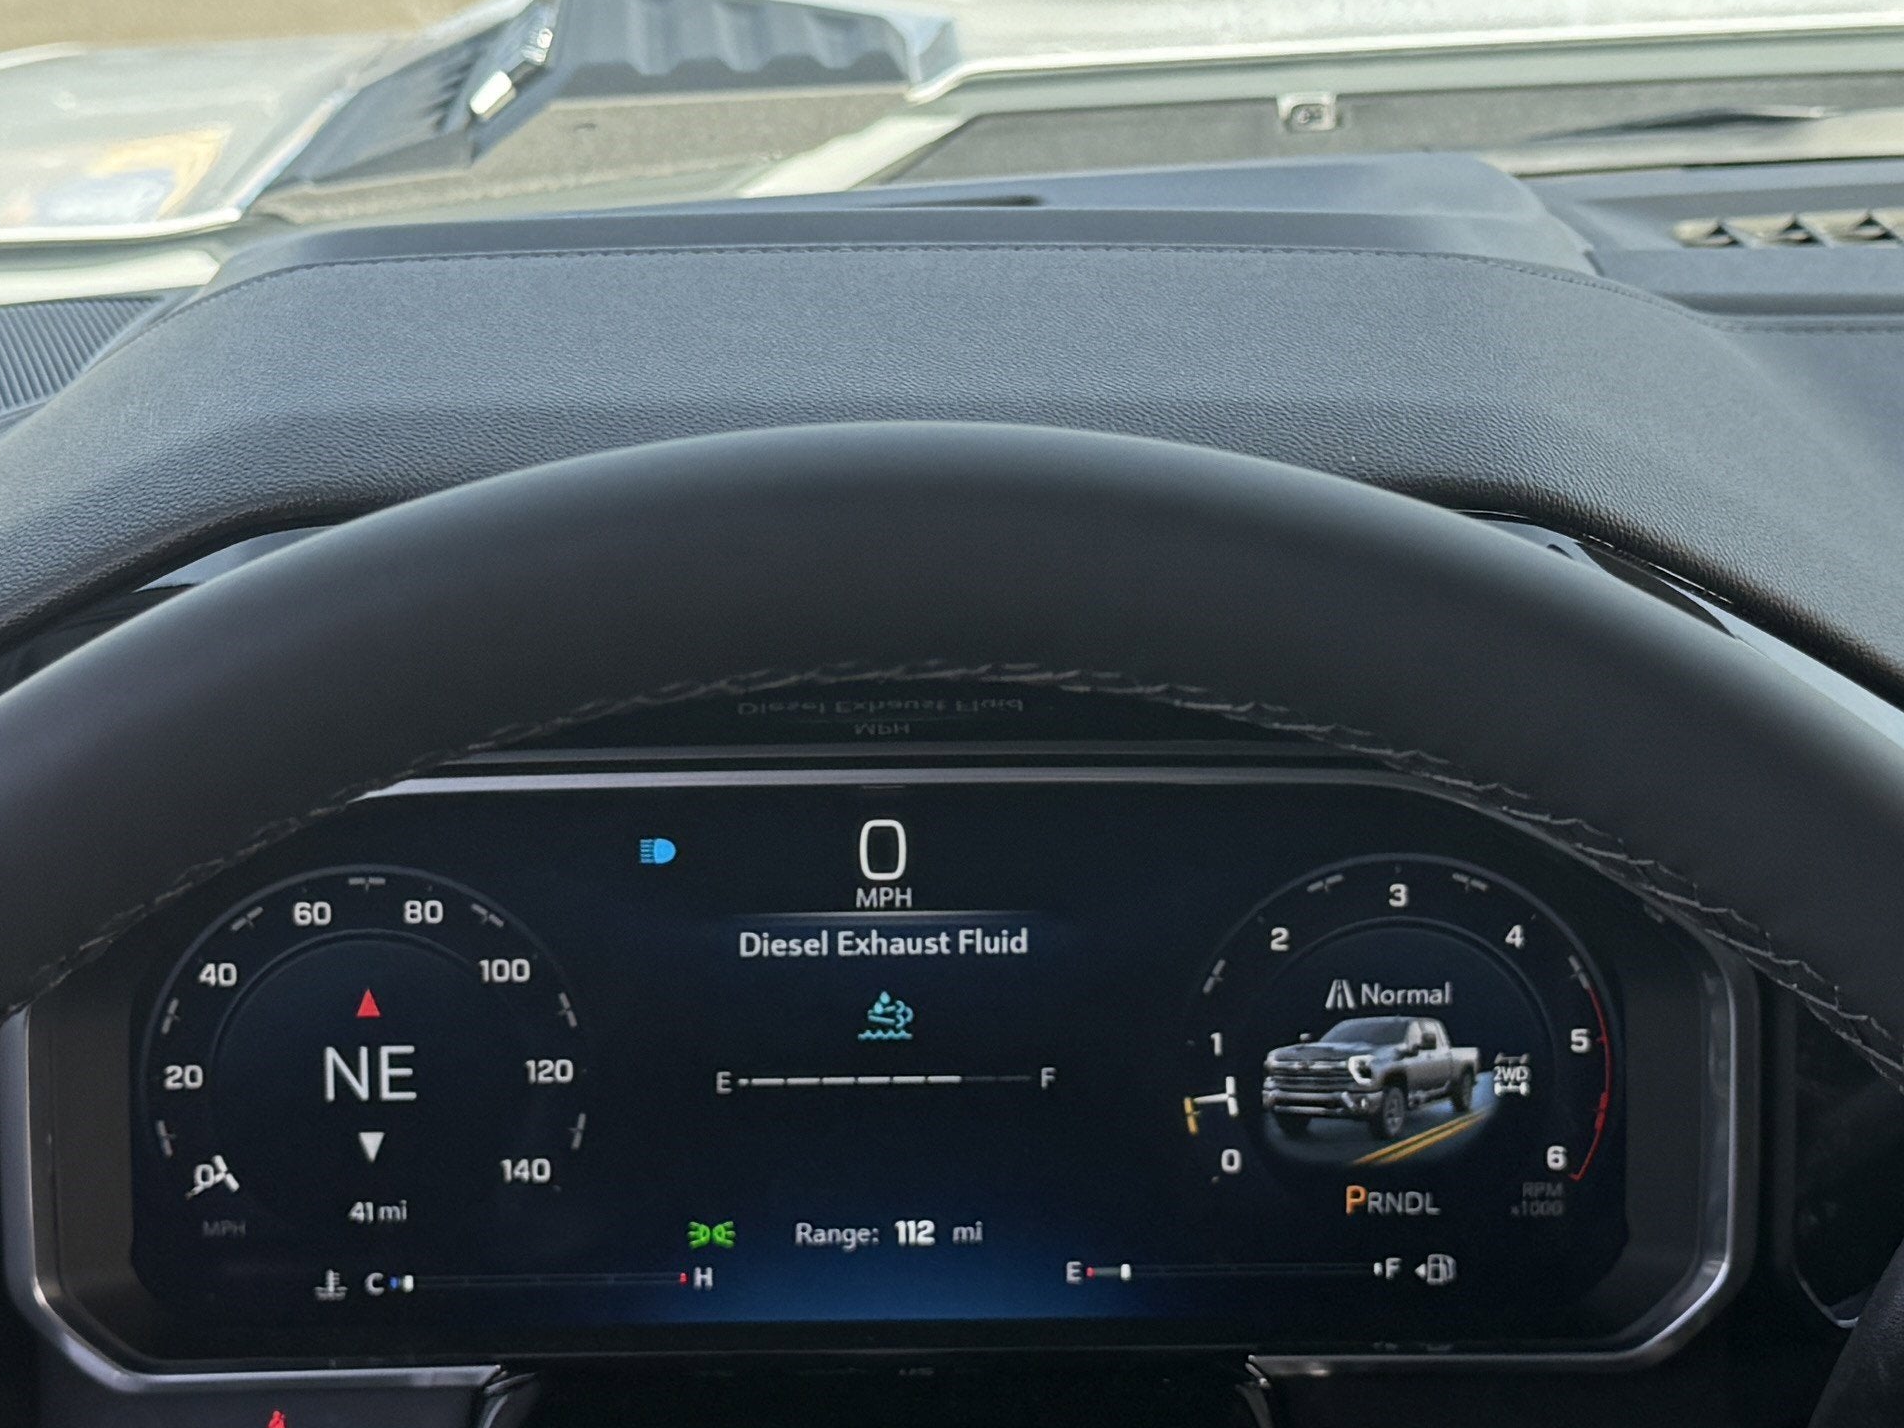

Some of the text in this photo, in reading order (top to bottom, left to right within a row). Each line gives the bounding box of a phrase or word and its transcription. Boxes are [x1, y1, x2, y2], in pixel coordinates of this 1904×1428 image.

[858, 819, 908, 881] 0
[855, 888, 913, 909] MPH
[1388, 883, 1408, 908] 3
[293, 900, 332, 926] 60
[404, 899, 444, 925] 80
[739, 928, 1029, 957] Diesel Exhaust Fluid
[1270, 926, 1289, 951] 2
[1505, 924, 1525, 948] 4
[198, 962, 239, 987] 40
[479, 958, 531, 984] 100
[1361, 981, 1452, 1006] Normal
[1211, 1032, 1224, 1056] 1
[1570, 1028, 1591, 1054] 5
[164, 1063, 204, 1090] 20
[322, 1044, 418, 1103] NE
[525, 1057, 575, 1084] 120
[716, 1071, 733, 1094] E
[1041, 1066, 1057, 1089] F
[1494, 1065, 1530, 1082] 2WD
[501, 1157, 552, 1184] 140
[1220, 1149, 1242, 1173] 0
[1546, 1145, 1568, 1171] 6
[348, 1199, 408, 1222] 41 mi
[795, 1220, 983, 1249] Range: 112 mi
[364, 1267, 714, 1295] C H
[1066, 1257, 1402, 1283] E F
